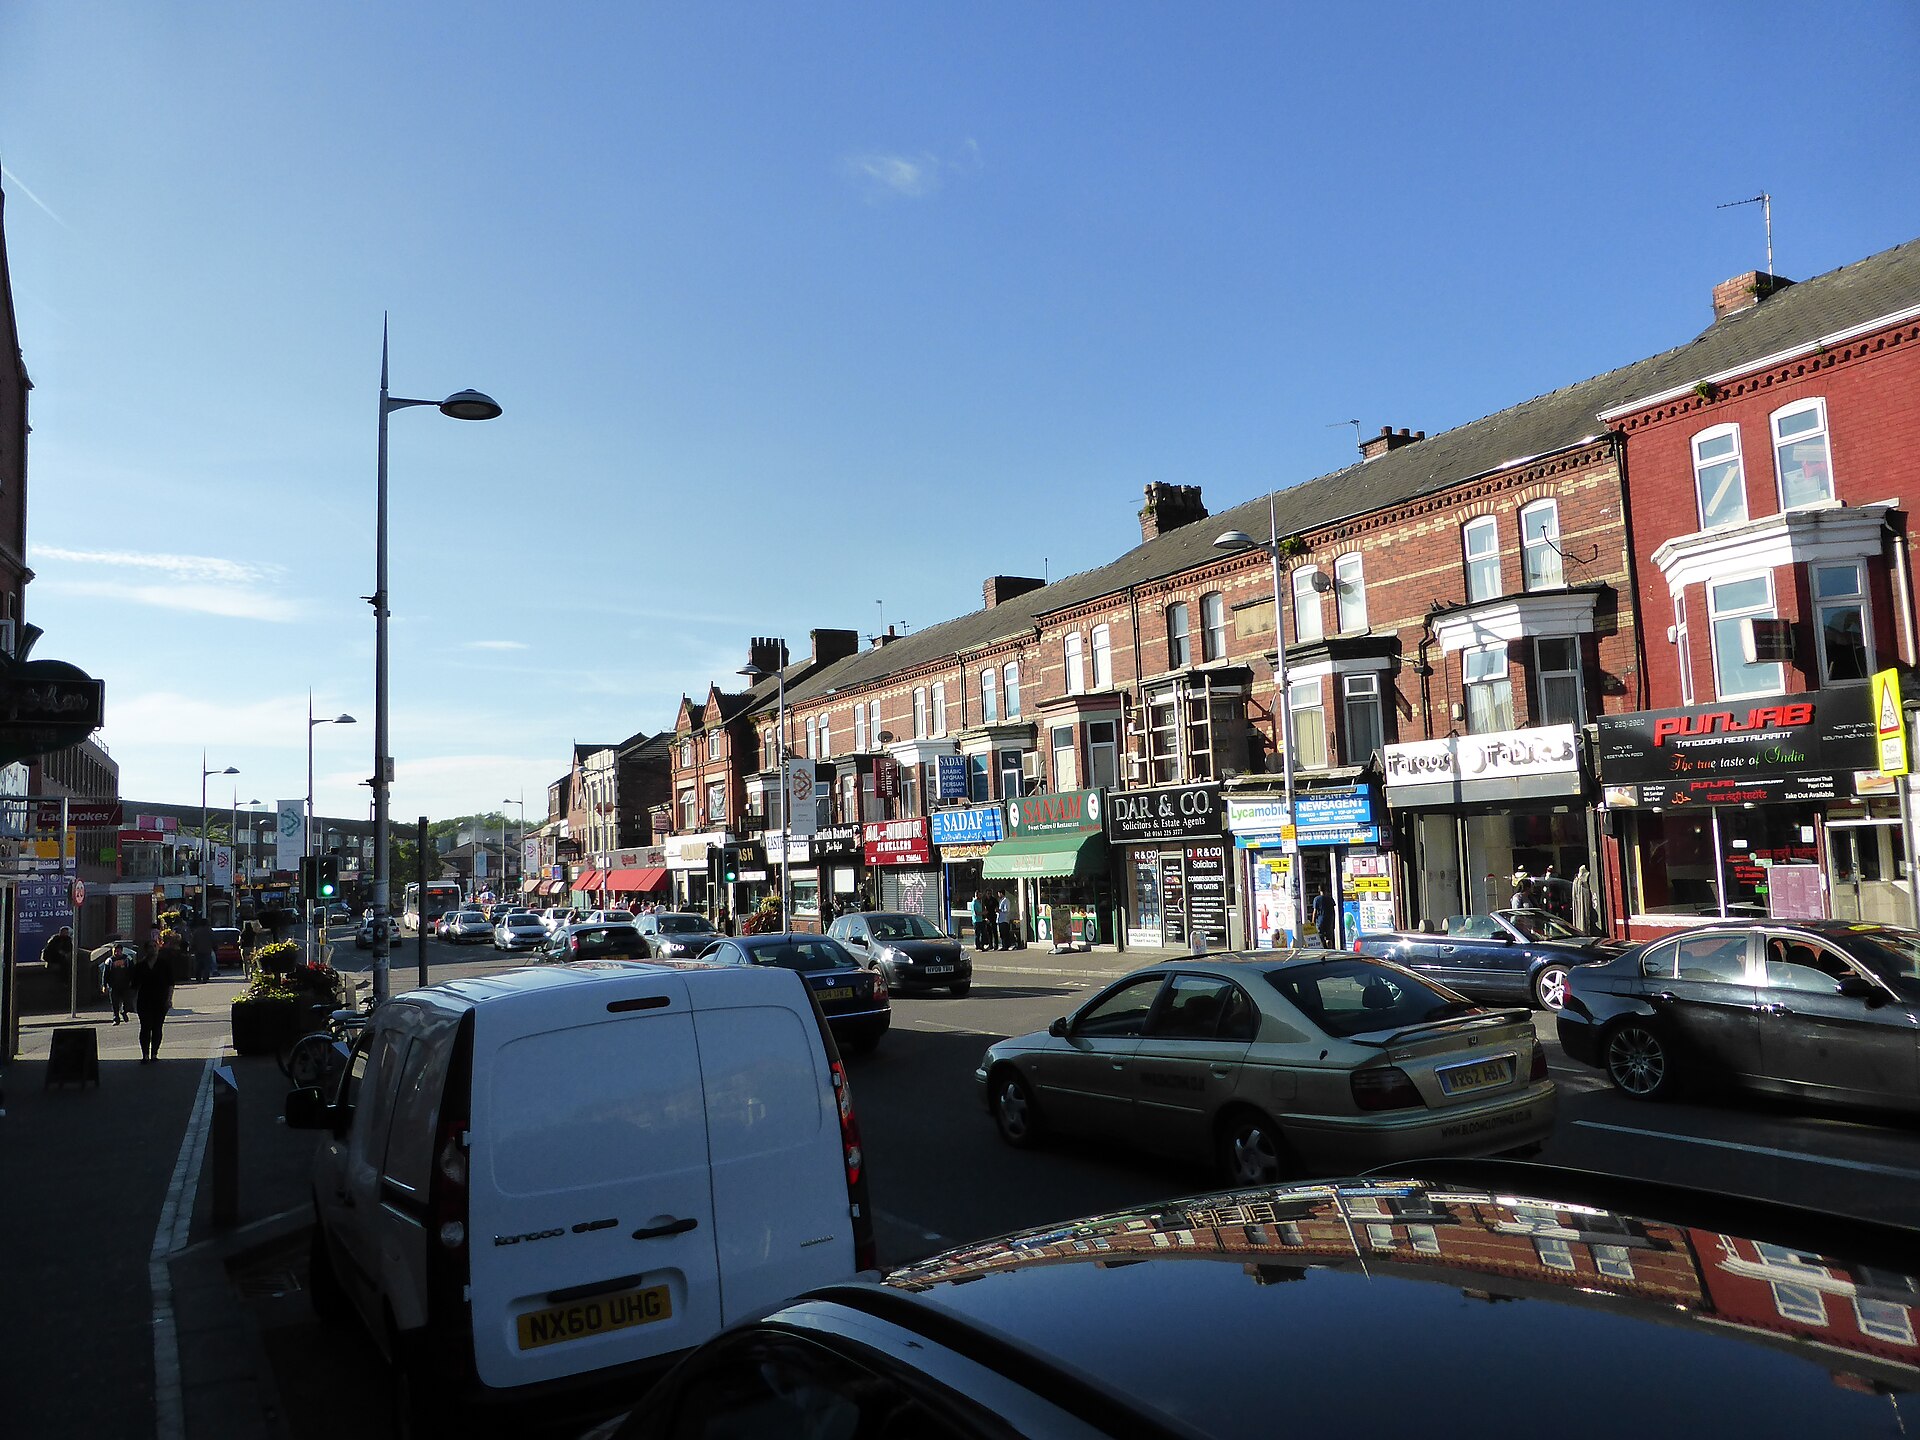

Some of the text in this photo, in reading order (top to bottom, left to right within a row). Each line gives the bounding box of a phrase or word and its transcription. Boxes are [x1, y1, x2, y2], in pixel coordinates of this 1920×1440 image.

[1654, 702, 1814, 746] PUNJAB
[1676, 732, 1792, 748] TANDOORI RESTAURANT
[940, 757, 964, 766] SADAF
[1669, 746, 1805, 771] The true taste of India
[1690, 780, 1734, 791] PUNJAB
[1023, 795, 1082, 824] SANAM
[1114, 790, 1213, 820] DAR & CO.
[1299, 798, 1363, 812] NEWSAGENT
[943, 811, 984, 832] SADAF
[1122, 818, 1205, 830] Solicitors & Estate Agents
[833, 826, 852, 839] Barbers
[866, 820, 922, 841] AL-NOOR
[1313, 829, 1339, 840] world
[1340, 829, 1352, 838] for
[1193, 860, 1217, 868] Solicitors
[530, 1291, 662, 1343] NX60 UHG
